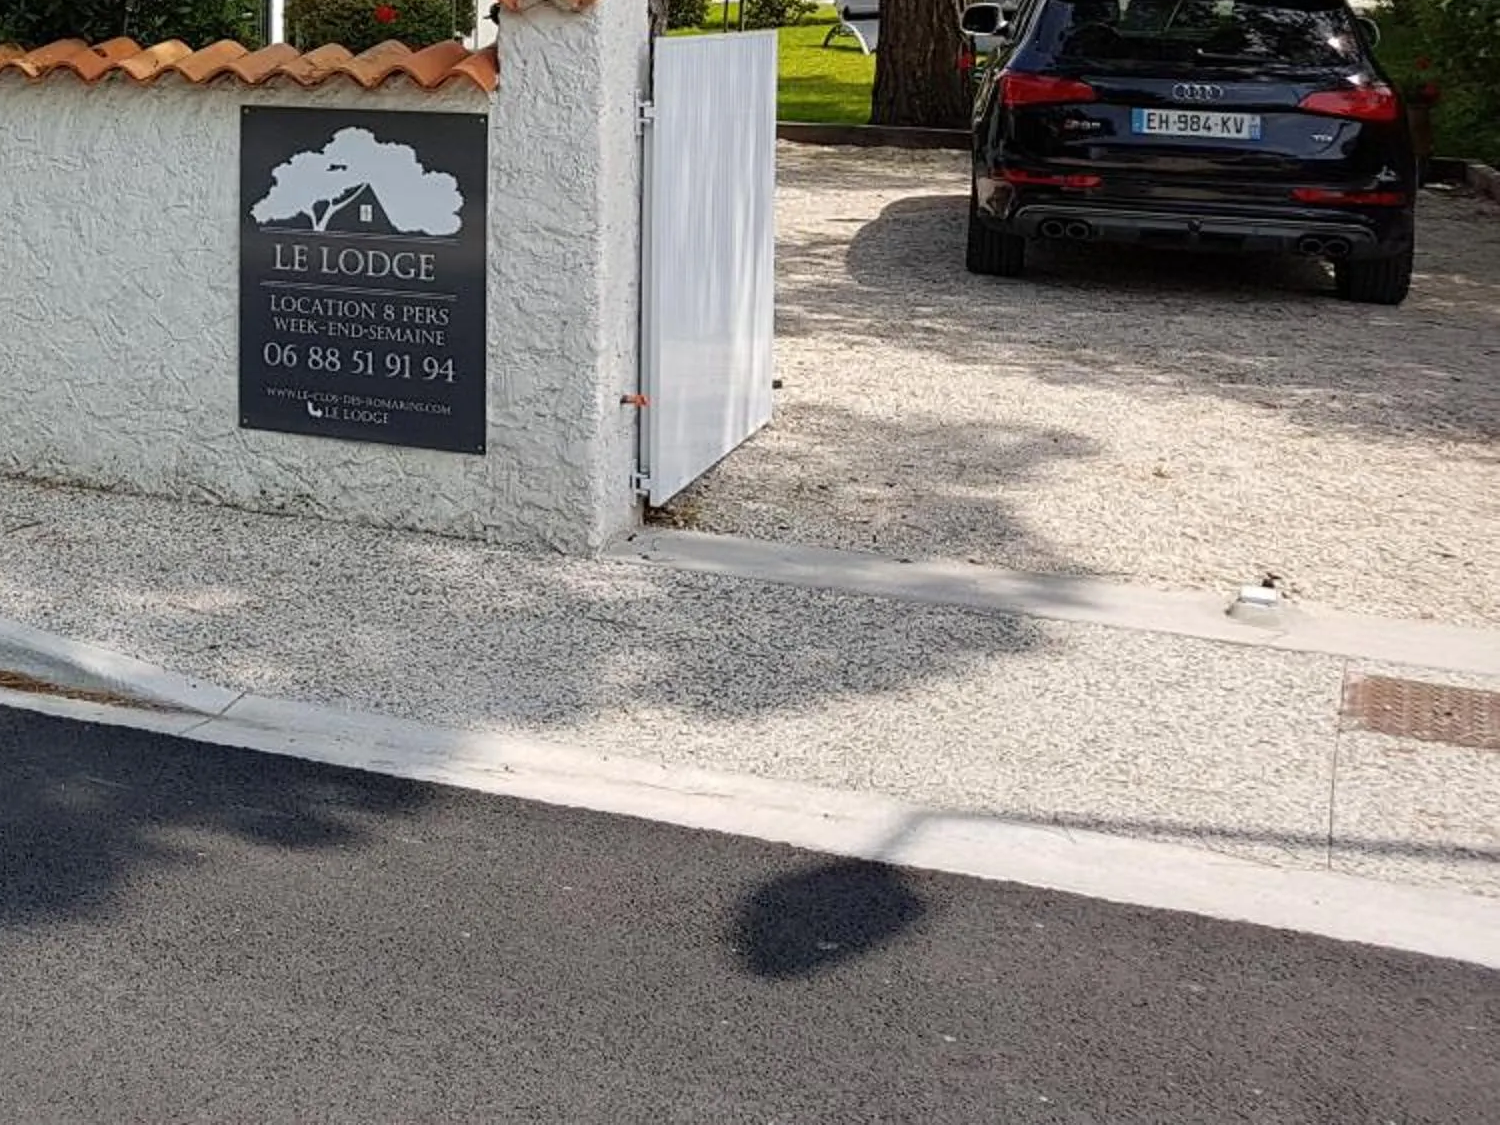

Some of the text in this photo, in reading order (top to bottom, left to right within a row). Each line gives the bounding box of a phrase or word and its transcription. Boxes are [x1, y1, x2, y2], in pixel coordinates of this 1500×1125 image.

[1146, 112, 1245, 134] EH-984-KV
[272, 243, 436, 280] LE LODGE
[270, 294, 450, 325] LOCATION 8 PERS
[263, 342, 456, 383] 06 88 51 91 94
[324, 406, 389, 424] LE LODGE
